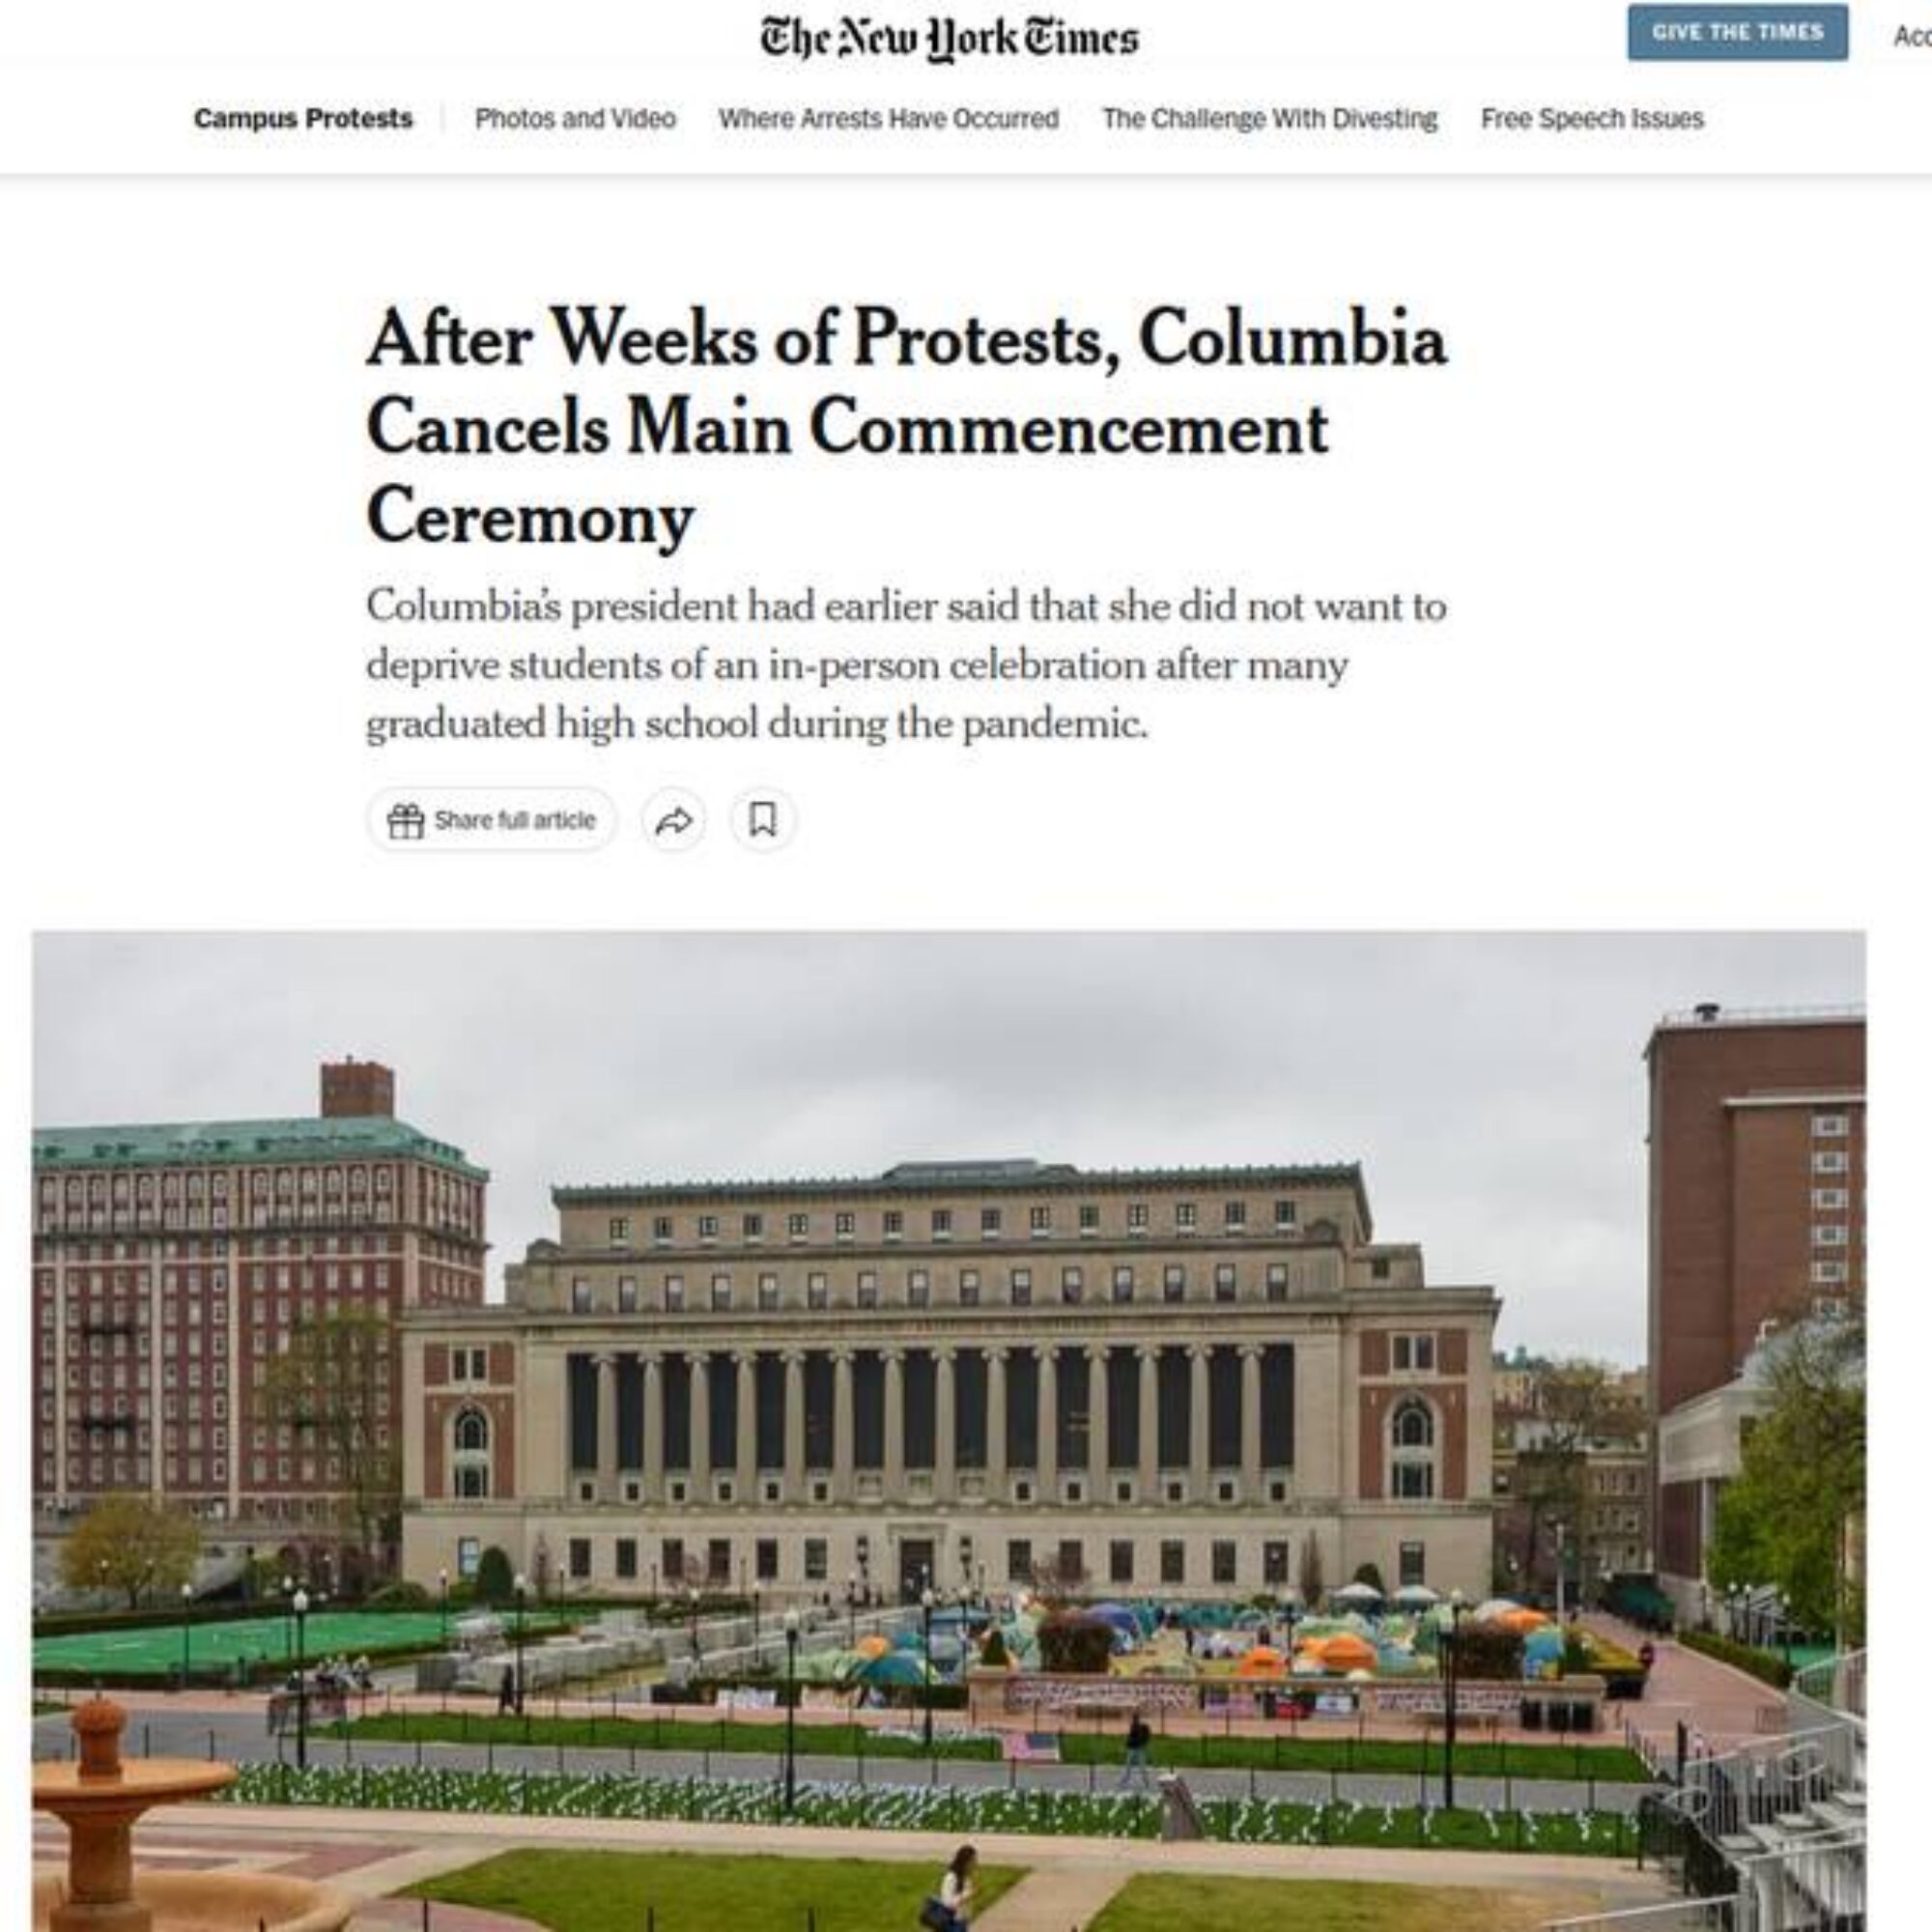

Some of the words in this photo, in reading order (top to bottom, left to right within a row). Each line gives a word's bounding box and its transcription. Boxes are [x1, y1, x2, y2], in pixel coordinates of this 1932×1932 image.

[760, 14, 832, 62] The
[837, 15, 919, 59] New
[924, 15, 1020, 67] York
[1024, 14, 1140, 58] Times
[1652, 22, 1704, 42] GIVE
[1708, 22, 1751, 42] THE
[1758, 22, 1825, 42] TIMES
[193, 107, 298, 134] Campus
[305, 107, 414, 129] Protests
[475, 107, 555, 129] Photos
[562, 108, 605, 128] and
[611, 108, 676, 128] Video
[719, 108, 795, 129] Where
[801, 107, 883, 129] Arrests
[890, 108, 948, 128] Have
[952, 107, 1060, 128] Occurred
[1103, 107, 1147, 128] The
[1151, 107, 1267, 134] Challenge
[1272, 107, 1326, 129] With
[1333, 107, 1438, 134] Divesting
[1482, 107, 1533, 128] Free
[1540, 107, 1626, 132] Speech
[1633, 108, 1705, 128] Issues
[365, 305, 534, 366] After
[549, 305, 758, 366] Weeks
[775, 305, 840, 366] of
[855, 305, 1120, 378] Protests,
[1140, 305, 1449, 366] Columbia
[367, 393, 611, 455] Cancels
[628, 393, 792, 455] Main
[810, 393, 1330, 455] Commencement
[367, 483, 697, 558] Ceremony
[572, 586, 737, 630] president
[749, 586, 815, 621] had
[825, 586, 940, 621] earlier
[948, 586, 1019, 621] said
[1030, 586, 1098, 621] that
[1110, 586, 1171, 621] she
[1179, 586, 1236, 621] did
[1249, 594, 1304, 621] not
[1315, 594, 1403, 621] want
[1413, 594, 1447, 620] to
[366, 645, 500, 689] deprive
[509, 645, 662, 680] students
[670, 645, 709, 680] of
[714, 658, 758, 680] an
[770, 648, 940, 689] in-person
[950, 645, 1147, 680] celebration
[1156, 646, 1239, 680] after
[1248, 658, 1349, 689] many
[367, 703, 546, 747] graduated
[557, 703, 636, 747] high
[645, 702, 757, 738] school
[768, 703, 888, 747] during
[897, 703, 953, 739] the
[963, 703, 1148, 748] pandemic.
[435, 810, 494, 830] Share
[498, 810, 527, 830] full
[535, 811, 596, 830] article
